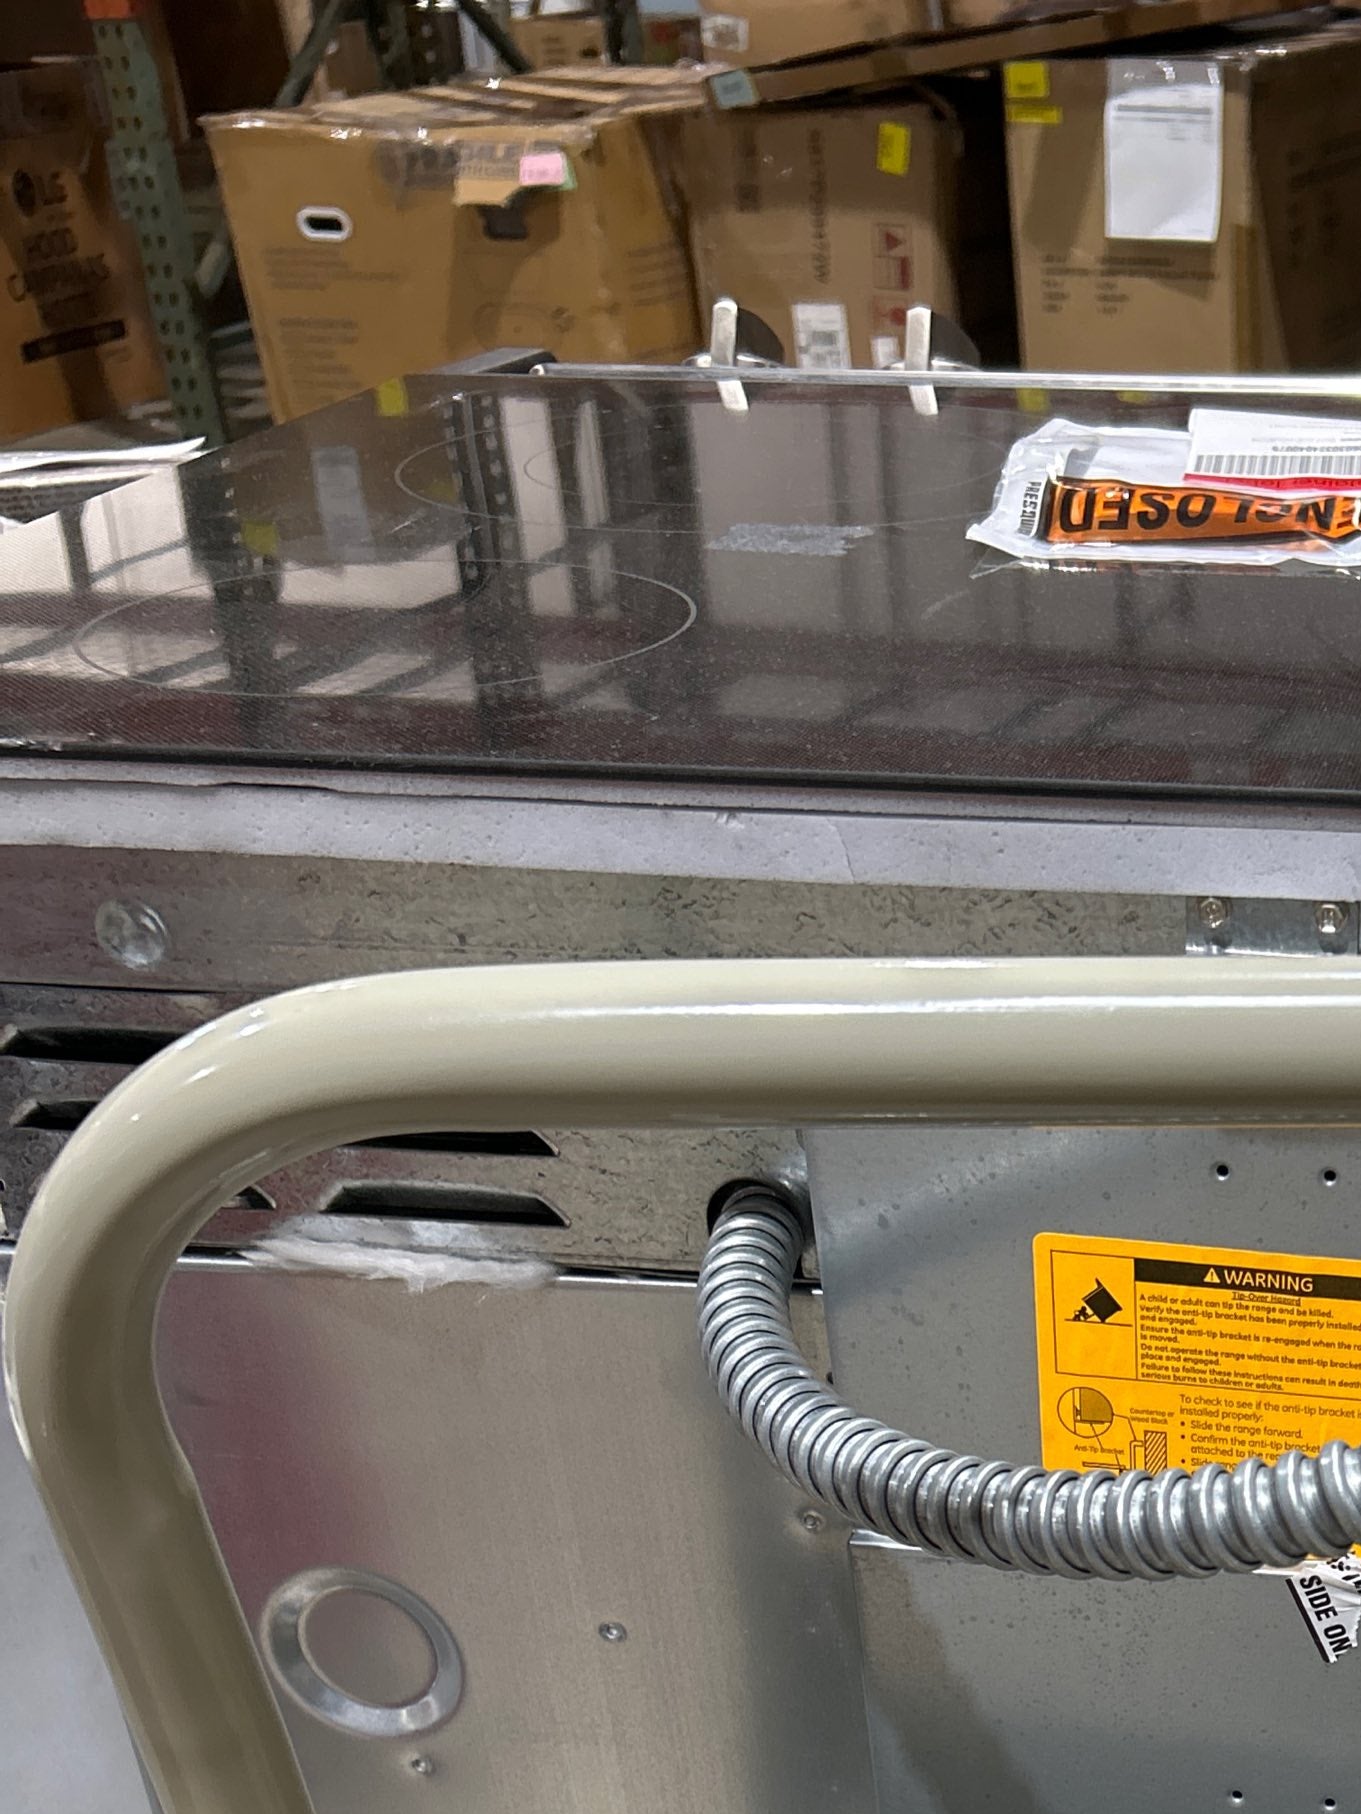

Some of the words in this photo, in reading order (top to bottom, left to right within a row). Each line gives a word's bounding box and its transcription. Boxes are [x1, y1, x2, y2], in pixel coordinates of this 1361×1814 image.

[1224, 1269, 1313, 1292] WARNING
[1147, 1294, 1168, 1303] child
[1180, 1297, 1203, 1306] adult
[1221, 1301, 1234, 1311] tip
[1235, 1302, 1250, 1310] the
[1251, 1306, 1277, 1314] range
[1278, 1306, 1295, 1314] and
[1308, 1309, 1334, 1317] killed.
[1232, 1292, 1268, 1303] Tip-Over
[1269, 1295, 1301, 1306] Hazard
[1139, 1304, 1164, 1315] Verify
[1166, 1306, 1180, 1314] the
[1181, 1308, 1213, 1319] anti-tip
[1214, 1311, 1247, 1320] bracket
[1266, 1315, 1287, 1323] been
[1288, 1317, 1324, 1329] properly
[1139, 1314, 1157, 1322] and
[1158, 1315, 1197, 1327] engaged.
[1140, 1324, 1169, 1333] Ensure
[1186, 1328, 1217, 1339] anti-tip
[1219, 1331, 1252, 1340] bracket
[1262, 1335, 1311, 1347] re-engaged
[1312, 1339, 1336, 1348] when
[1337, 1341, 1352, 1349] the
[1149, 1334, 1180, 1343] moved.
[1140, 1352, 1163, 1362] place
[1165, 1354, 1181, 1362] and
[1182, 1355, 1221, 1367] engaged.
[1154, 1344, 1168, 1352] not
[1170, 1345, 1203, 1357] operate
[1204, 1348, 1219, 1356] the
[1220, 1352, 1245, 1361] range
[1246, 1352, 1279, 1362] without
[1281, 1355, 1295, 1363] the
[1297, 1357, 1328, 1368] anti-tip
[1329, 1360, 1361, 1369] bracket
[1140, 1362, 1169, 1371] Failure
[1171, 1364, 1180, 1372] to
[1182, 1365, 1207, 1374] follow
[1208, 1368, 1232, 1376] these
[1233, 1370, 1283, 1381] instructions
[1302, 1376, 1326, 1385] result
[1328, 1378, 1336, 1386] in
[1141, 1371, 1171, 1380] serious
[1172, 1374, 1197, 1382] burns
[1209, 1377, 1243, 1387] children
[1255, 1381, 1284, 1390] adults.
[1179, 1406, 1220, 1417] installed
[1221, 1409, 1263, 1423] properly:
[1180, 1394, 1192, 1403] To
[1193, 1395, 1222, 1406] check
[1224, 1398, 1234, 1407] to
[1255, 1401, 1262, 1409] if
[1263, 1401, 1280, 1411] the
[1281, 1403, 1317, 1416] anti-tip
[1318, 1406, 1355, 1417] bracket
[1190, 1420, 1213, 1430] Slide
[1215, 1422, 1231, 1431] the
[1233, 1426, 1261, 1436] range
[1263, 1426, 1302, 1438] forward.
[1190, 1433, 1228, 1445] Confirm
[1230, 1437, 1246, 1446] the
[1248, 1439, 1283, 1452] anti-tip
[1190, 1445, 1233, 1457] attached
[1235, 1449, 1246, 1458] to
[1299, 1575, 1338, 1621] SIDE
